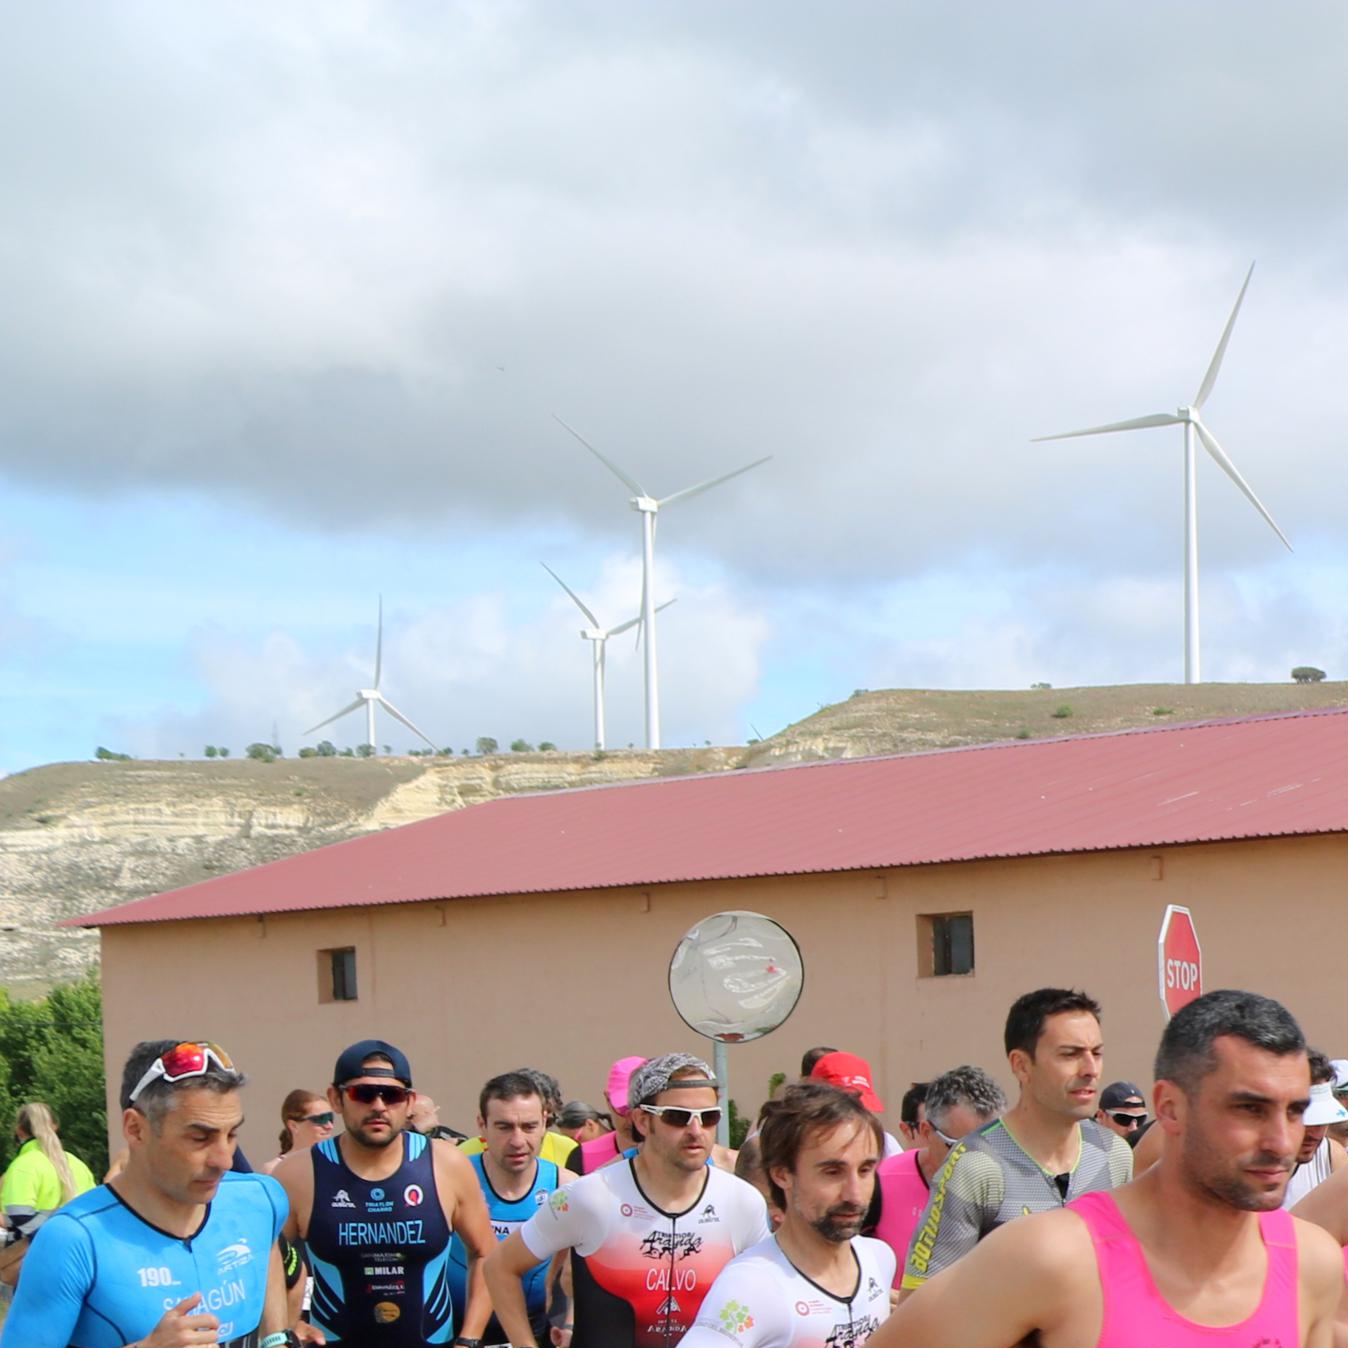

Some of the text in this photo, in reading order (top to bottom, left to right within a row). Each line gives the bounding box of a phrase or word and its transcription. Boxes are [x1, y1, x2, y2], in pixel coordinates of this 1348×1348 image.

[1167, 959, 1198, 991] STOP
[338, 1220, 426, 1246] HERNANDEZ
[137, 1267, 173, 1287] 190
[375, 1266, 405, 1275] MILAR
[646, 1268, 697, 1292] CALVO
[162, 1279, 247, 1316] SAGÚN
